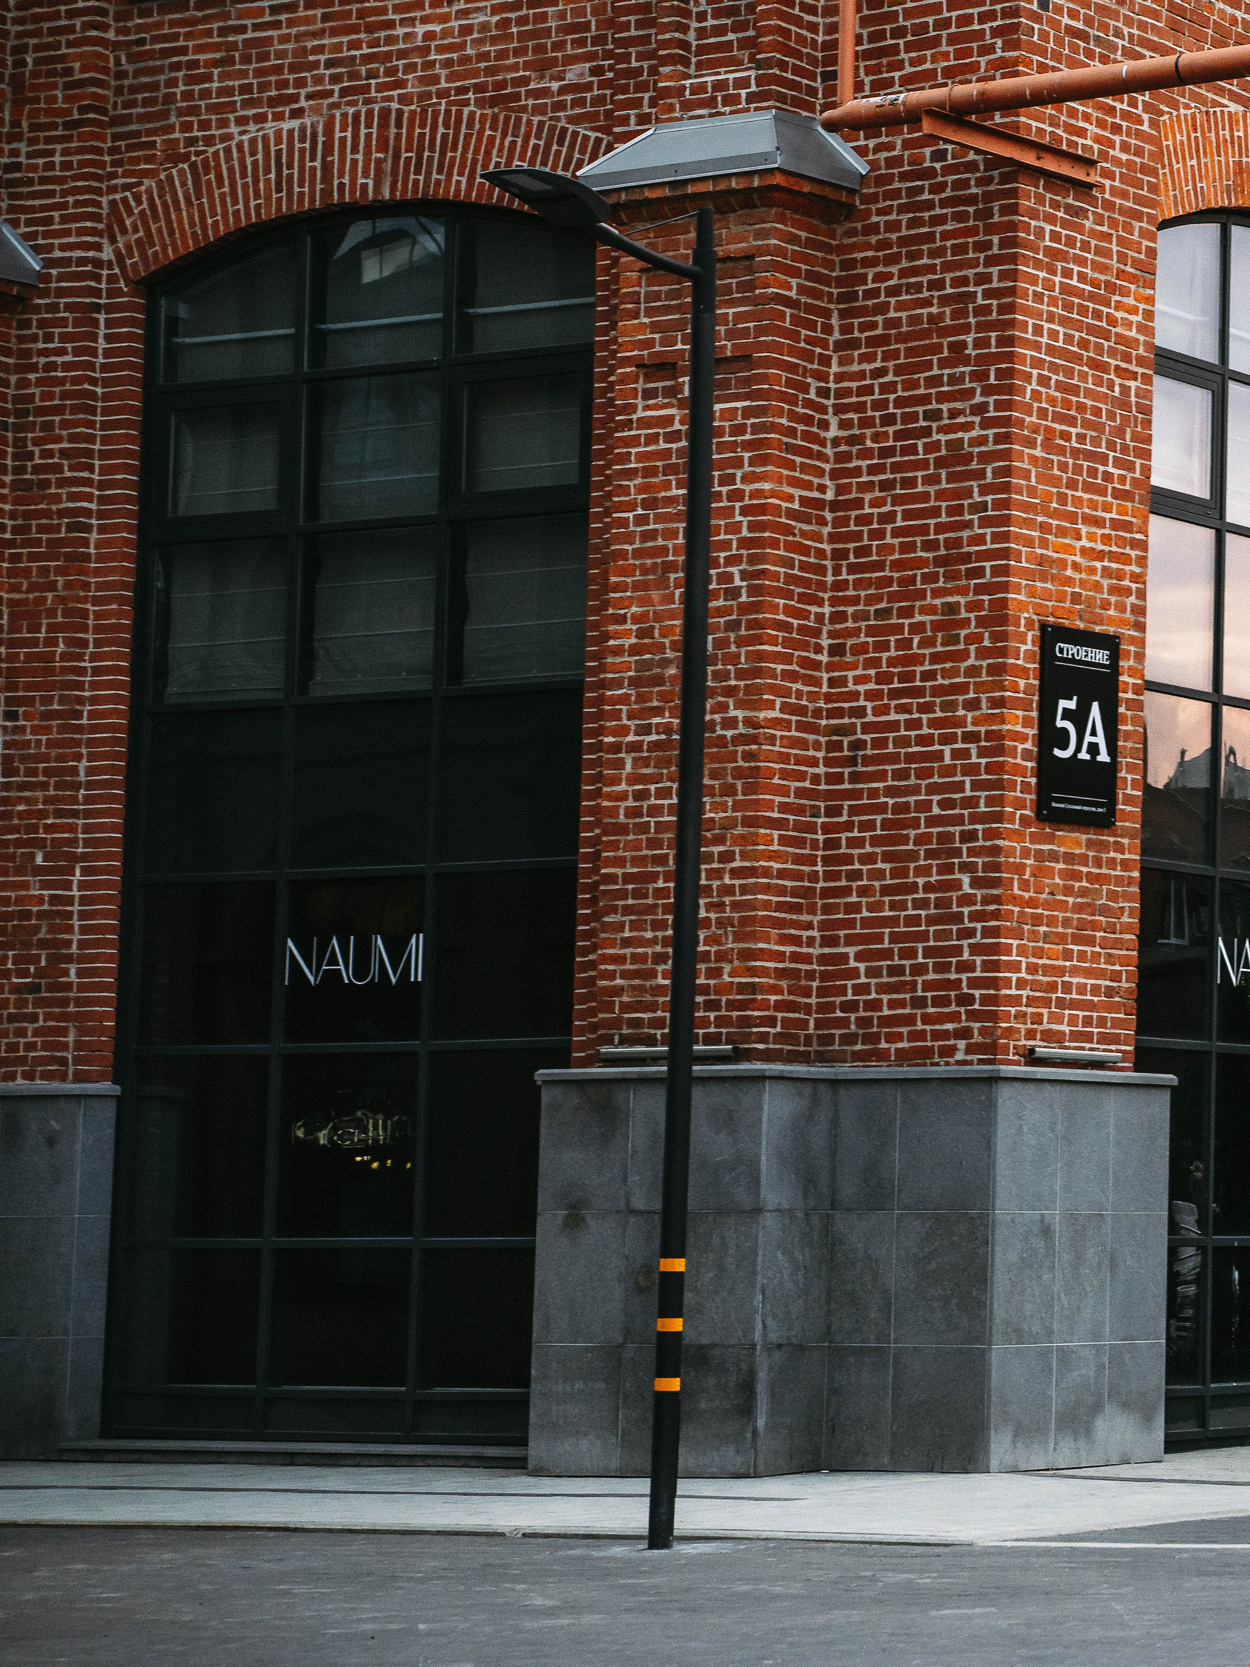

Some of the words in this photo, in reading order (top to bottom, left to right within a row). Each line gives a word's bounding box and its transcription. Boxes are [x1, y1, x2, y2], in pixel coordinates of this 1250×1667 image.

[1055, 642, 1110, 665] СТРОЕНИЕ
[1052, 695, 1112, 763] 5А
[284, 933, 424, 987] NAUMI
